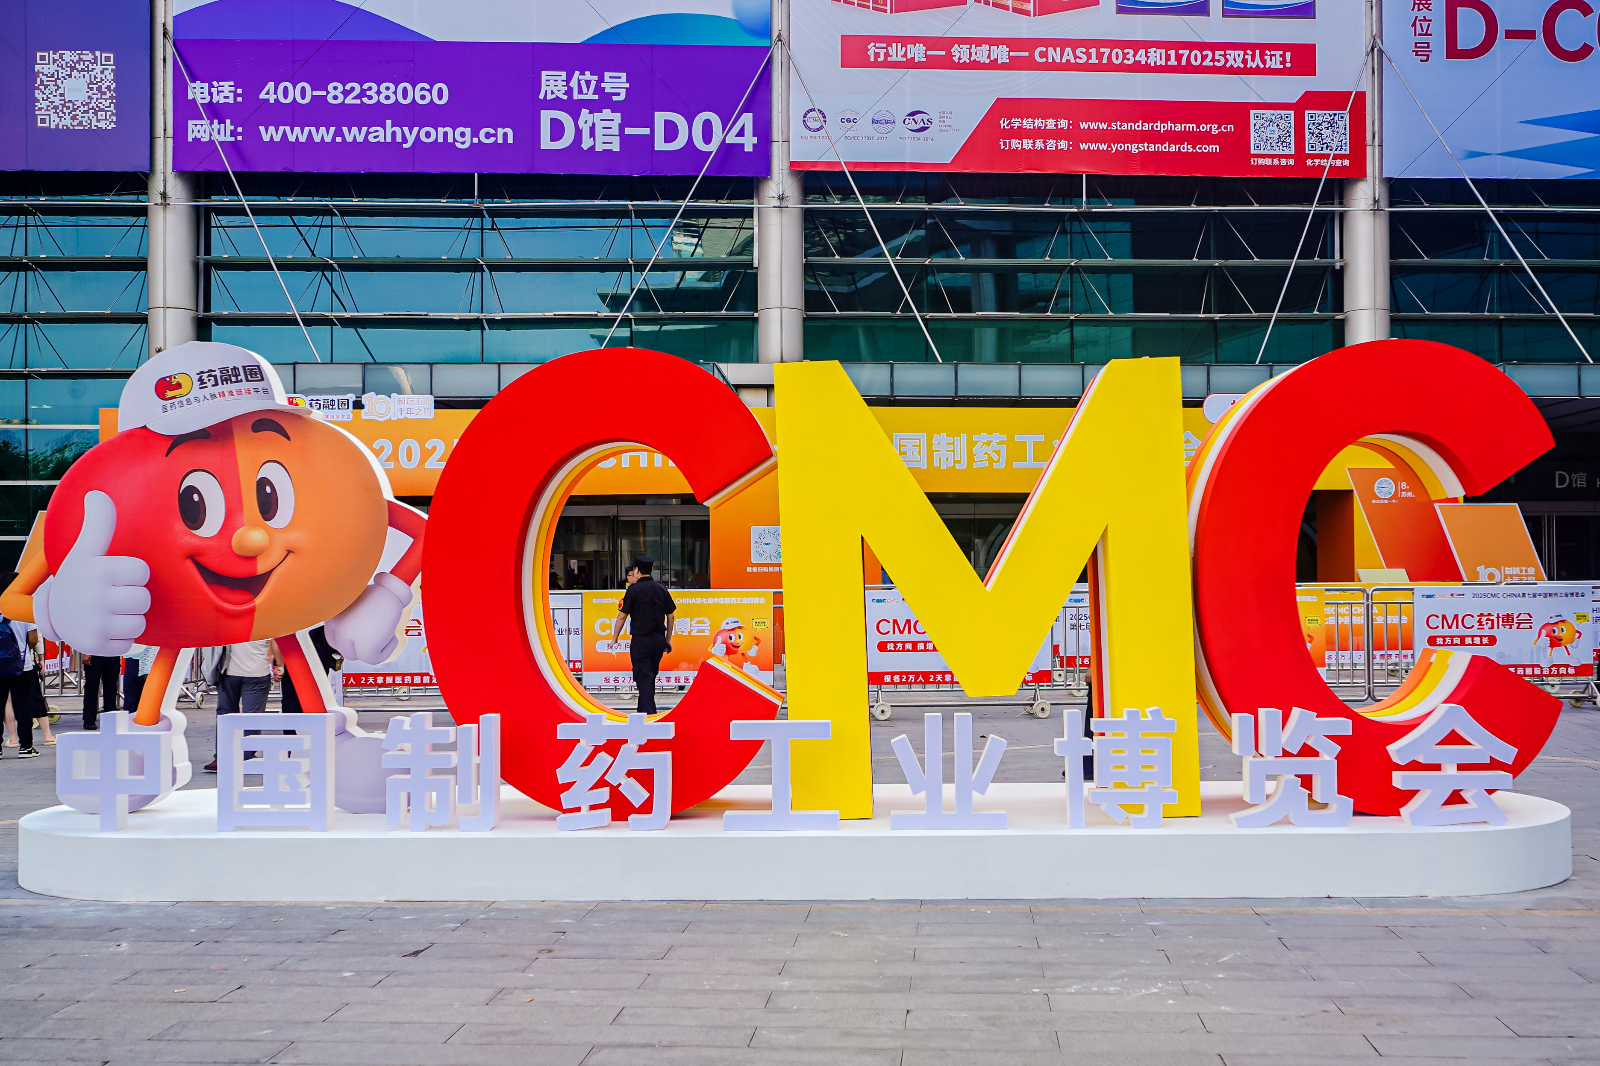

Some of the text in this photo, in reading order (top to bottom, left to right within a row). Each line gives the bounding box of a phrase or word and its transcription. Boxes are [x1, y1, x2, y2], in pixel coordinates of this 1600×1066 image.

[1445, 0, 1600, 63] D-C
[867, 42, 946, 63] 行业唯一
[951, 44, 1029, 65] 领域唯一
[258, 81, 449, 105] 400-8238060
[538, 70, 630, 101] 展位号
[540, 108, 758, 152] D馆-D04
[902, 117, 933, 126] CNAS
[1079, 120, 1235, 133] www.standardpharm.org.cn
[258, 120, 514, 149] www.wahyong.cn
[1079, 141, 1220, 154] www.yongstandards.com
[1250, 157, 1295, 166] 订购联系咨询
[195, 364, 265, 391] 药融圈
[308, 398, 350, 411] 药融圈
[372, 438, 449, 469] 202
[1555, 470, 1588, 489] D馆
[422, 339, 1563, 819] CMC
[403, 618, 422, 637] 会
[1425, 612, 1534, 631] CMC药博会
[887, 642, 934, 651] 找方向 搞增
[1436, 636, 1490, 646] 找方向 搞增长
[603, 676, 635, 684] 报名2万
[884, 674, 924, 683] 报名2万人
[55, 706, 1518, 832] 中国制药工业博览会
